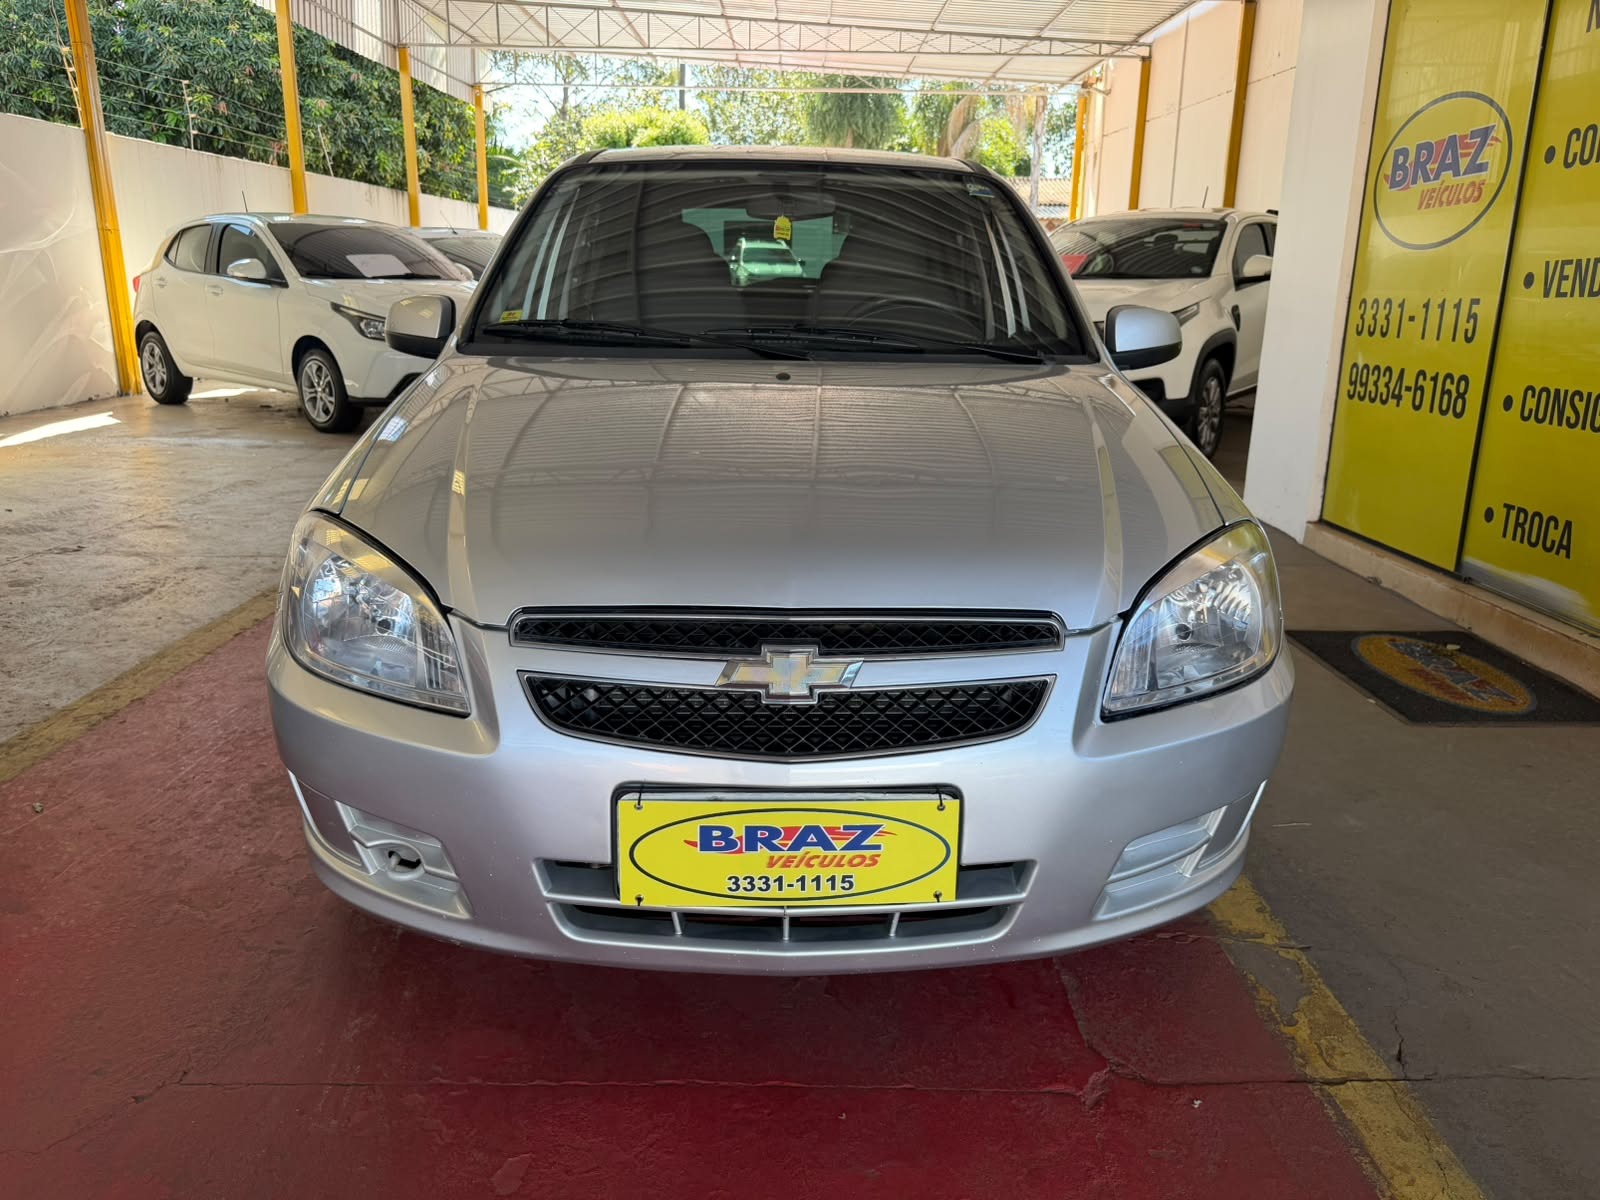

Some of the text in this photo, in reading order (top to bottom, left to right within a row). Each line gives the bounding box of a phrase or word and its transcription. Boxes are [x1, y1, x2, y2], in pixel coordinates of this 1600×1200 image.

[1388, 123, 1497, 191] BRAZ
[1563, 124, 1600, 169] CO
[1417, 179, 1486, 210] VEÍCULOS
[1356, 297, 1480, 343] 3331-1115
[1347, 362, 1470, 419] 99334-6168
[1501, 502, 1573, 560] TROCA
[697, 824, 886, 853] BRAZ
[765, 851, 882, 869] VEÍCULOS
[726, 874, 855, 893] 3331-1115
